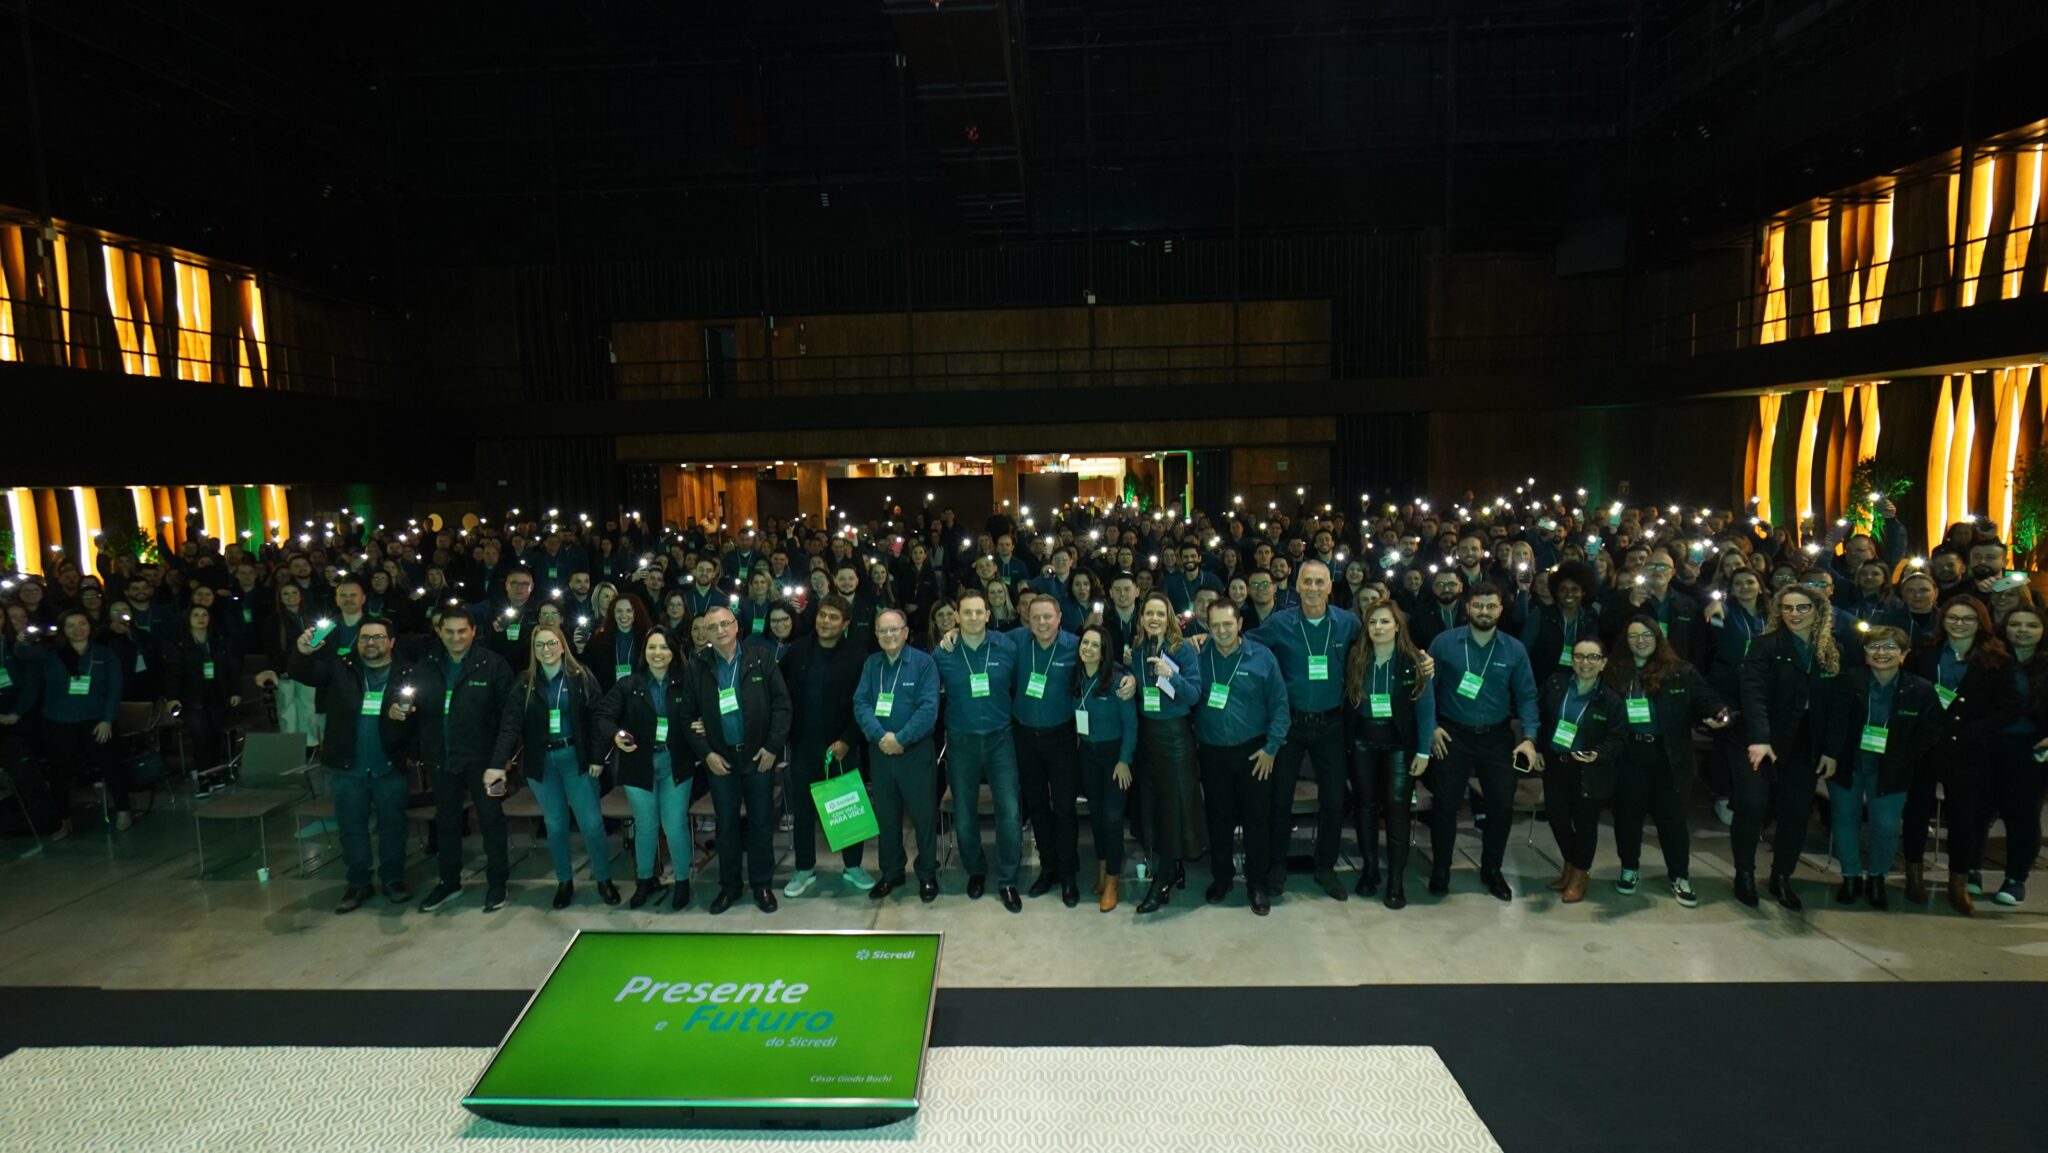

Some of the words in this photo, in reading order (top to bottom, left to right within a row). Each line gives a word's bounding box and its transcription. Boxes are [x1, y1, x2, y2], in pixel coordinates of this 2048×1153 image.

[829, 814, 847, 826] PARA
[872, 950, 915, 960] Sicredi
[614, 976, 809, 1004] Presente
[655, 1020, 668, 1031] e
[682, 1004, 834, 1033] Futuro
[765, 1037, 784, 1047] do
[787, 1036, 837, 1048] Sicredi
